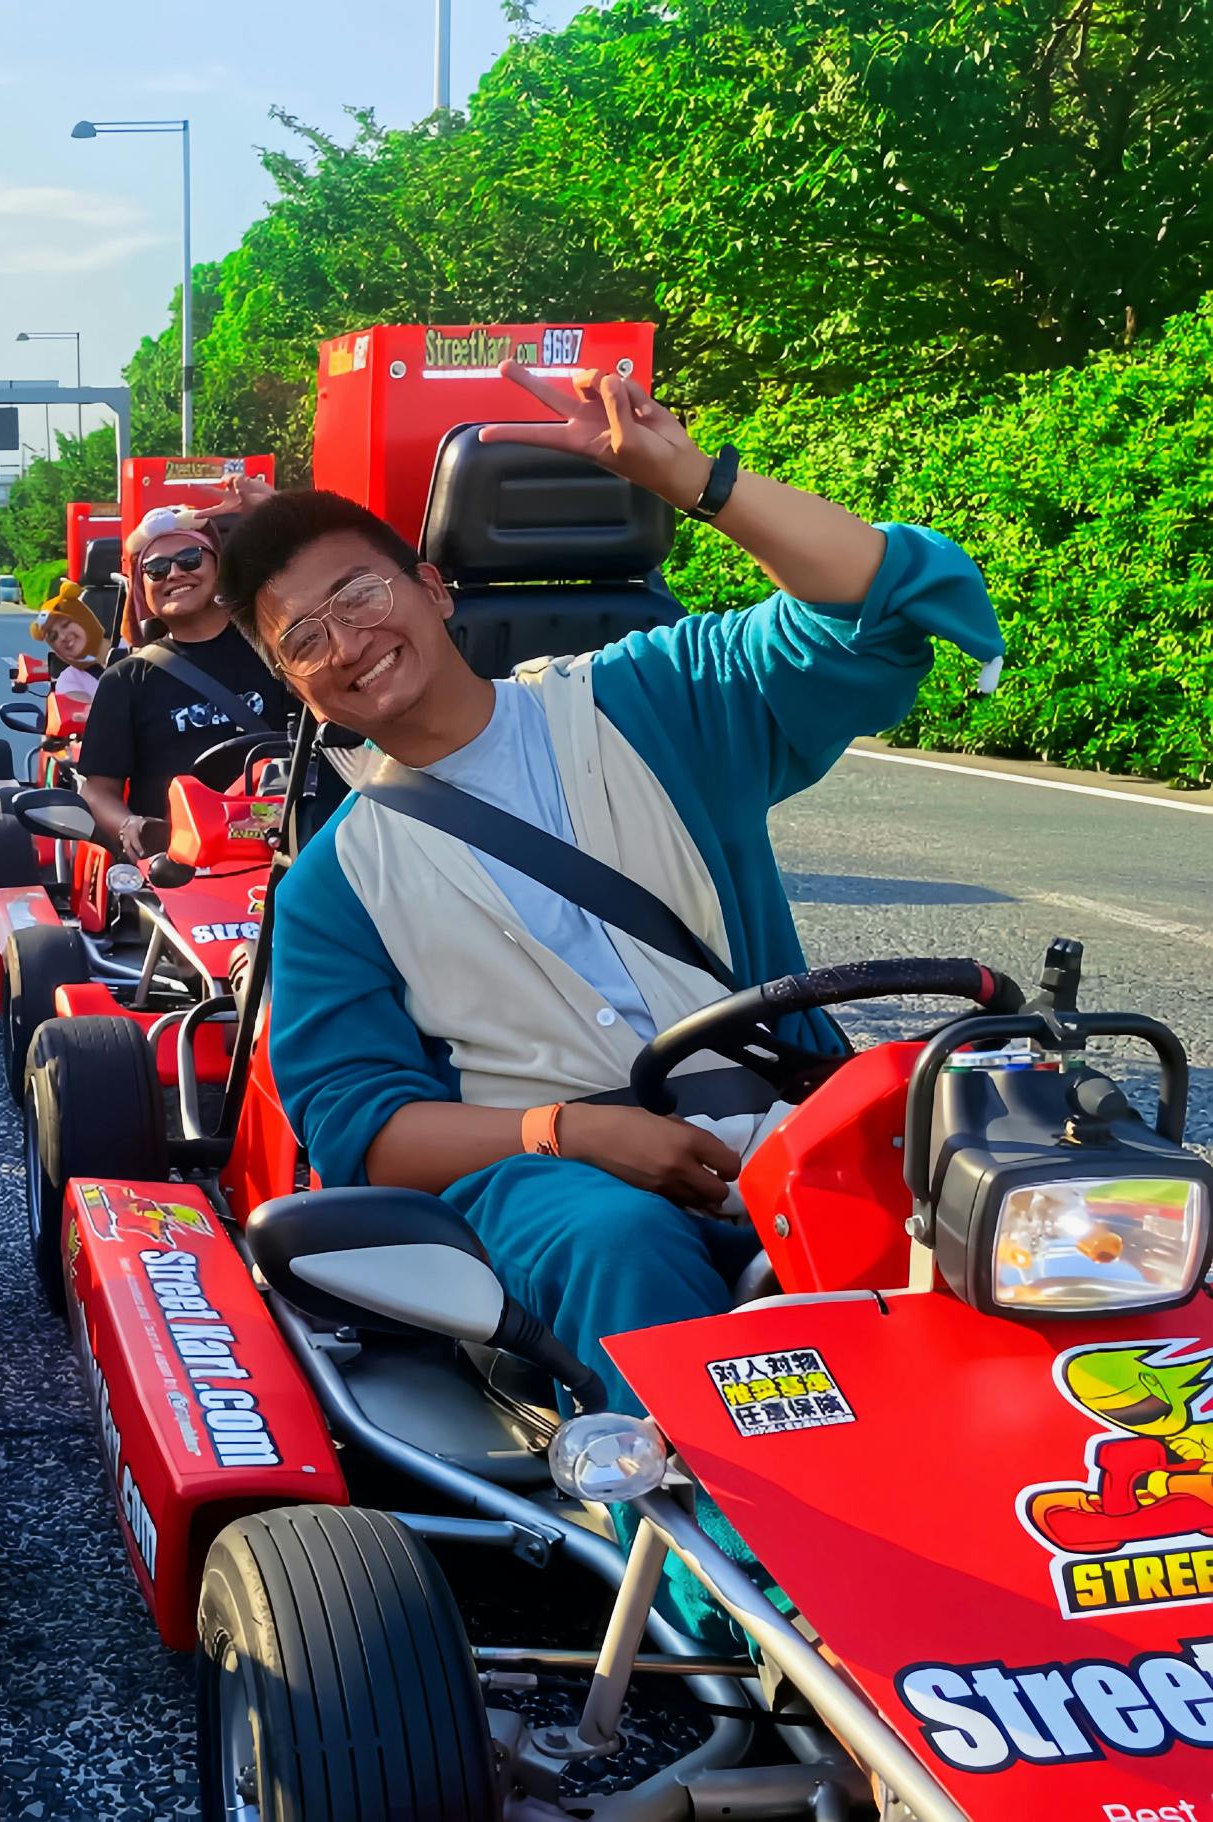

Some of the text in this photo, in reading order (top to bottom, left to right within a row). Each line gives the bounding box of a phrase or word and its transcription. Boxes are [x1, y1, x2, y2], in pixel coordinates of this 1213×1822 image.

[139, 1249, 221, 1320] Street
[903, 1641, 1213, 1768] Stree
[1102, 1799, 1198, 1822] Best
